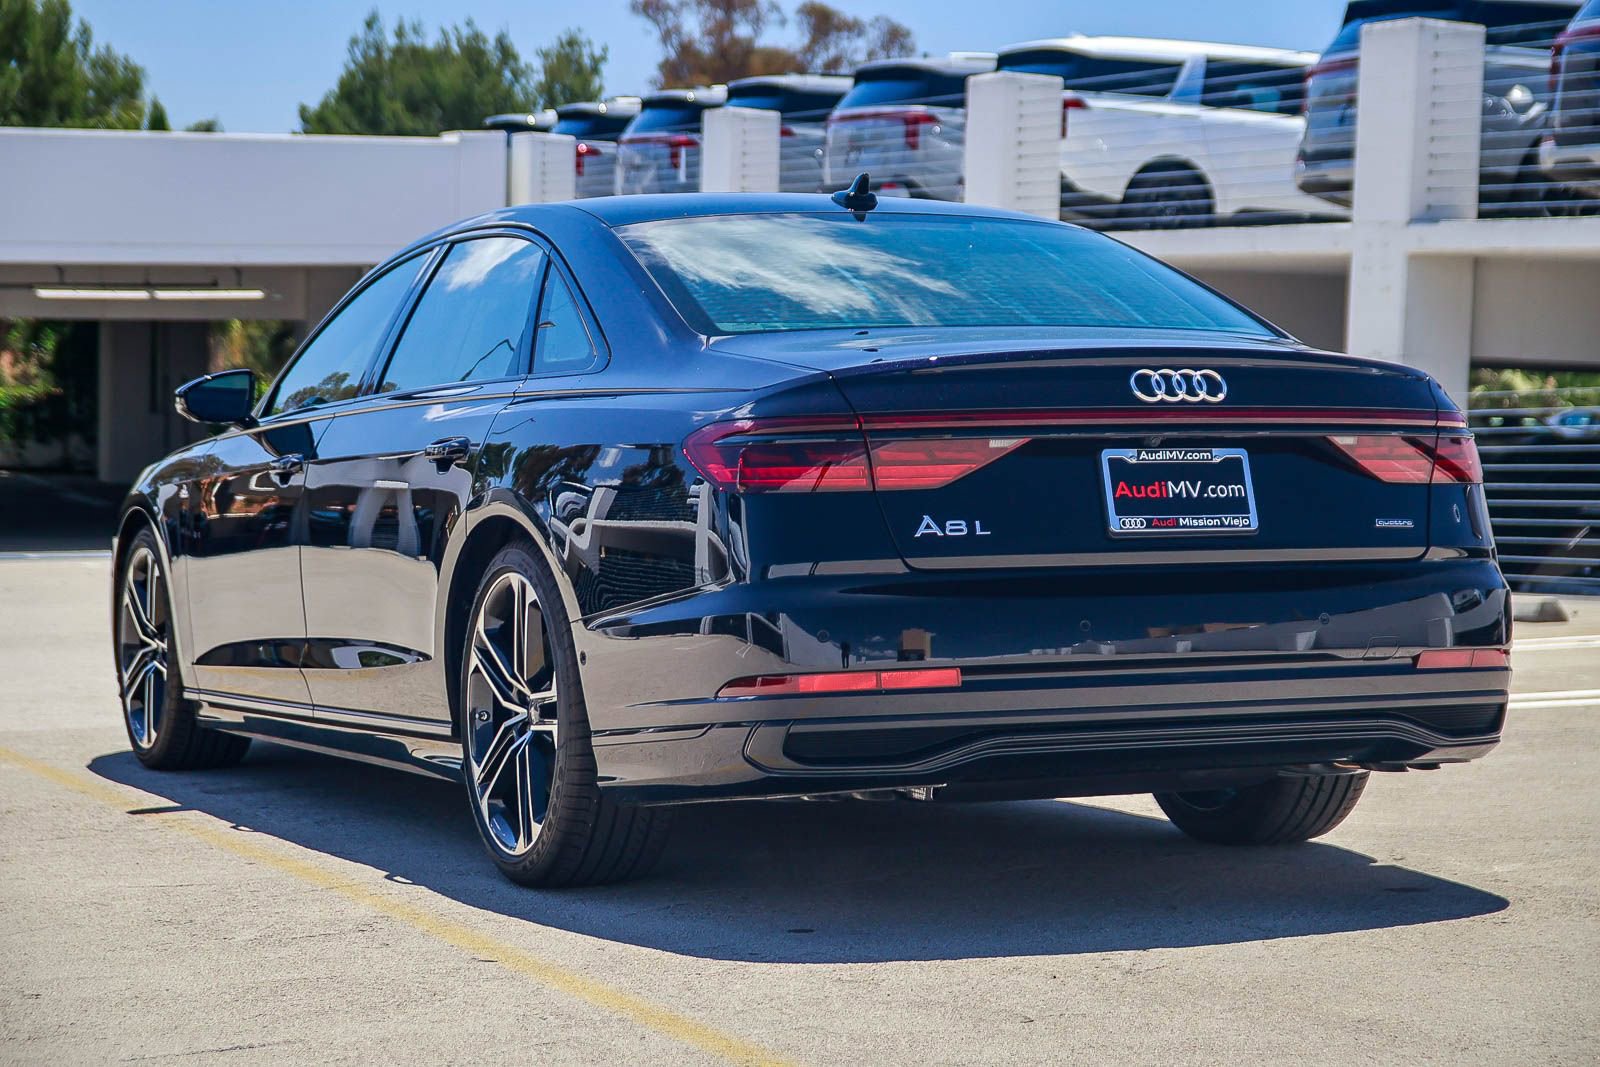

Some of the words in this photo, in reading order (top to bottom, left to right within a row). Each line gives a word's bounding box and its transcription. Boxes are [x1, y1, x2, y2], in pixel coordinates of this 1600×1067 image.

[1139, 450, 1212, 461] AudiMV.com
[1115, 480, 1246, 499] AudiMV.com
[913, 514, 968, 538] A8
[974, 519, 992, 536] L
[1151, 517, 1177, 527] Audi
[1179, 517, 1221, 527] Mission
[1221, 517, 1250, 527] Viejo
